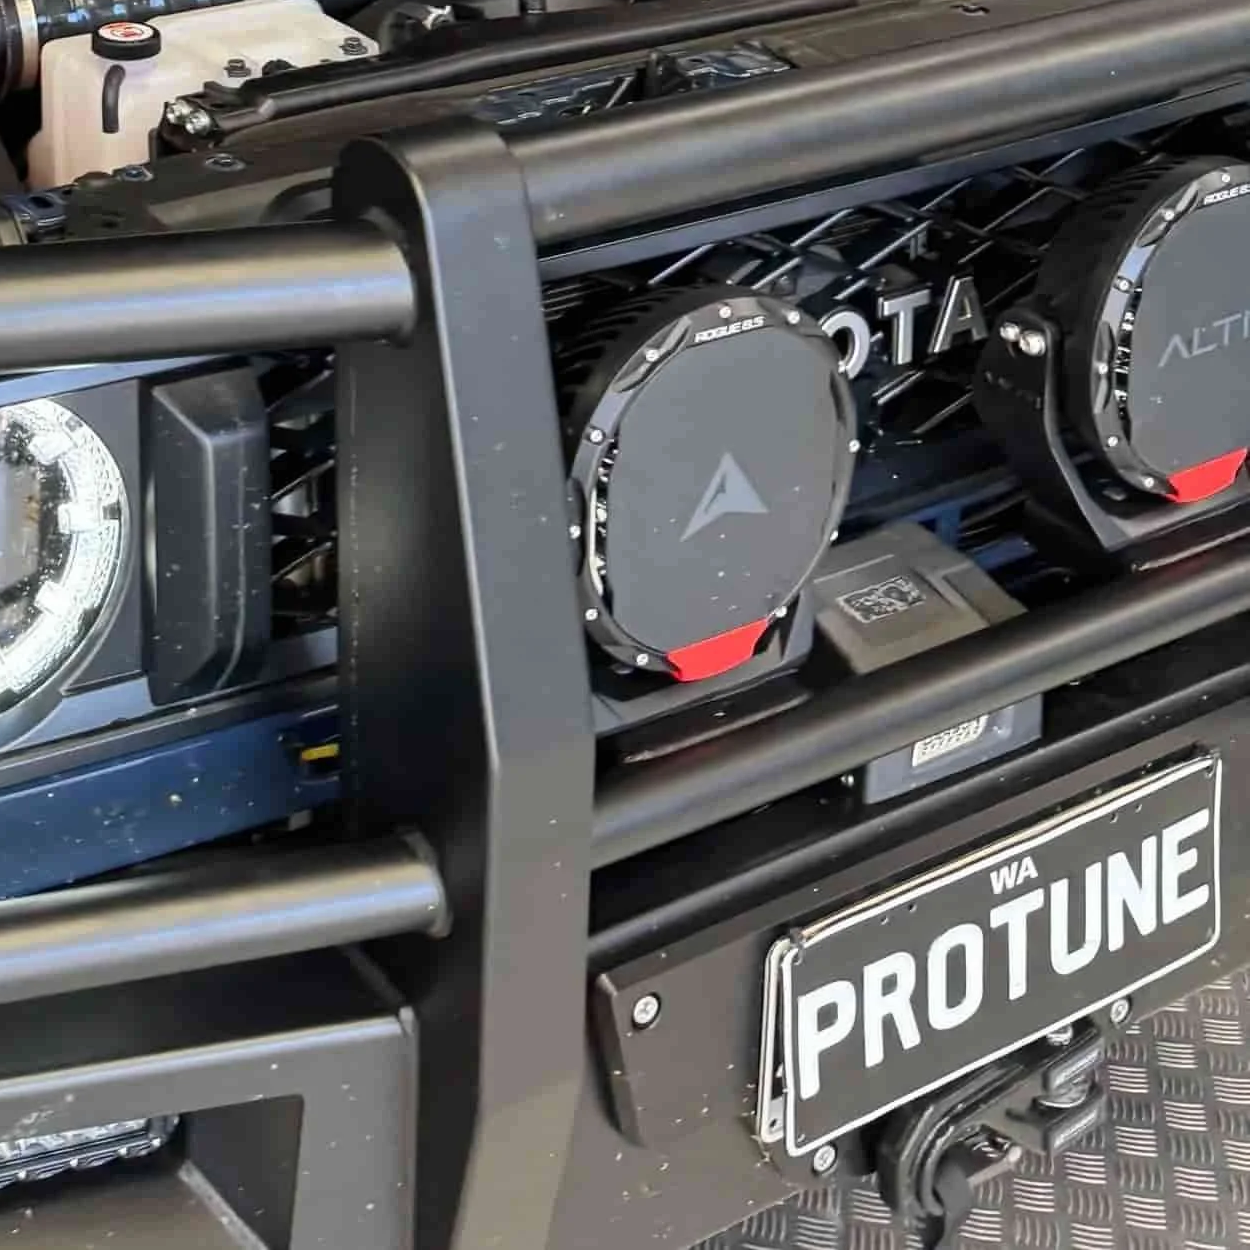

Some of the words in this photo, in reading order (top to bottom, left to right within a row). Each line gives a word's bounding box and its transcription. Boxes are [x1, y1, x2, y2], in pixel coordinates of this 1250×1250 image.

[694, 321, 743, 343] ROGUE
[990, 856, 1039, 895] WA
[797, 808, 1210, 1100] PROTUNE
